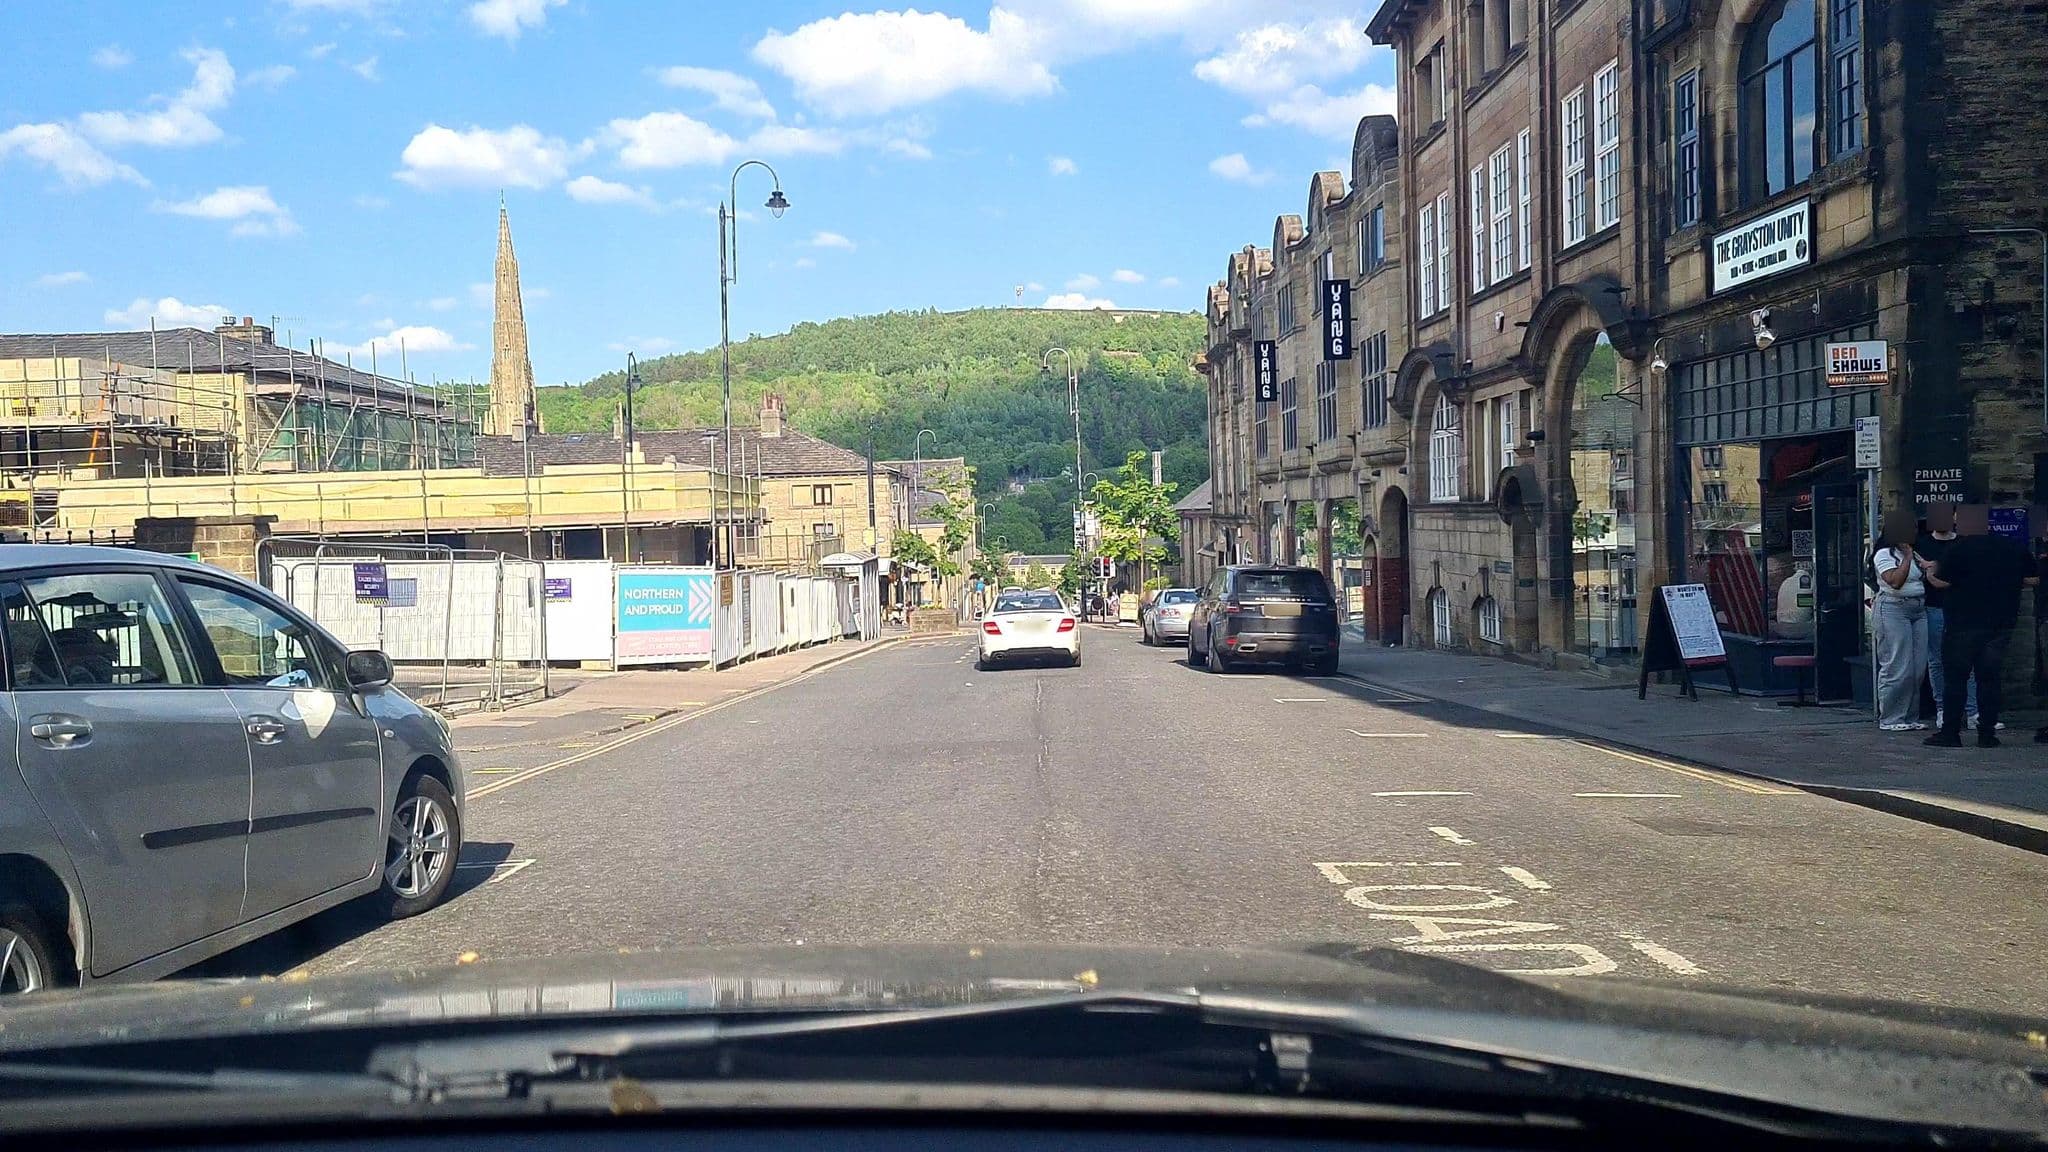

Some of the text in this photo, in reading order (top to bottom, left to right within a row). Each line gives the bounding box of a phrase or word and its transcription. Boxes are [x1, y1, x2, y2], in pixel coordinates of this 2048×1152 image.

[1716, 239, 1731, 265] THE
[1731, 221, 1776, 259] GRAYSTON
[1777, 210, 1805, 242] UNITY
[1832, 347, 1858, 359] BEN
[1833, 358, 1882, 372] SHAWS
[1915, 469, 1962, 479] PRIVATE
[1930, 483, 1948, 492] NO
[1916, 494, 1964, 503] PARKING
[1993, 524, 2019, 532] VALLEY
[624, 588, 683, 600] NORTHERN
[624, 604, 683, 615] AND PROUD
